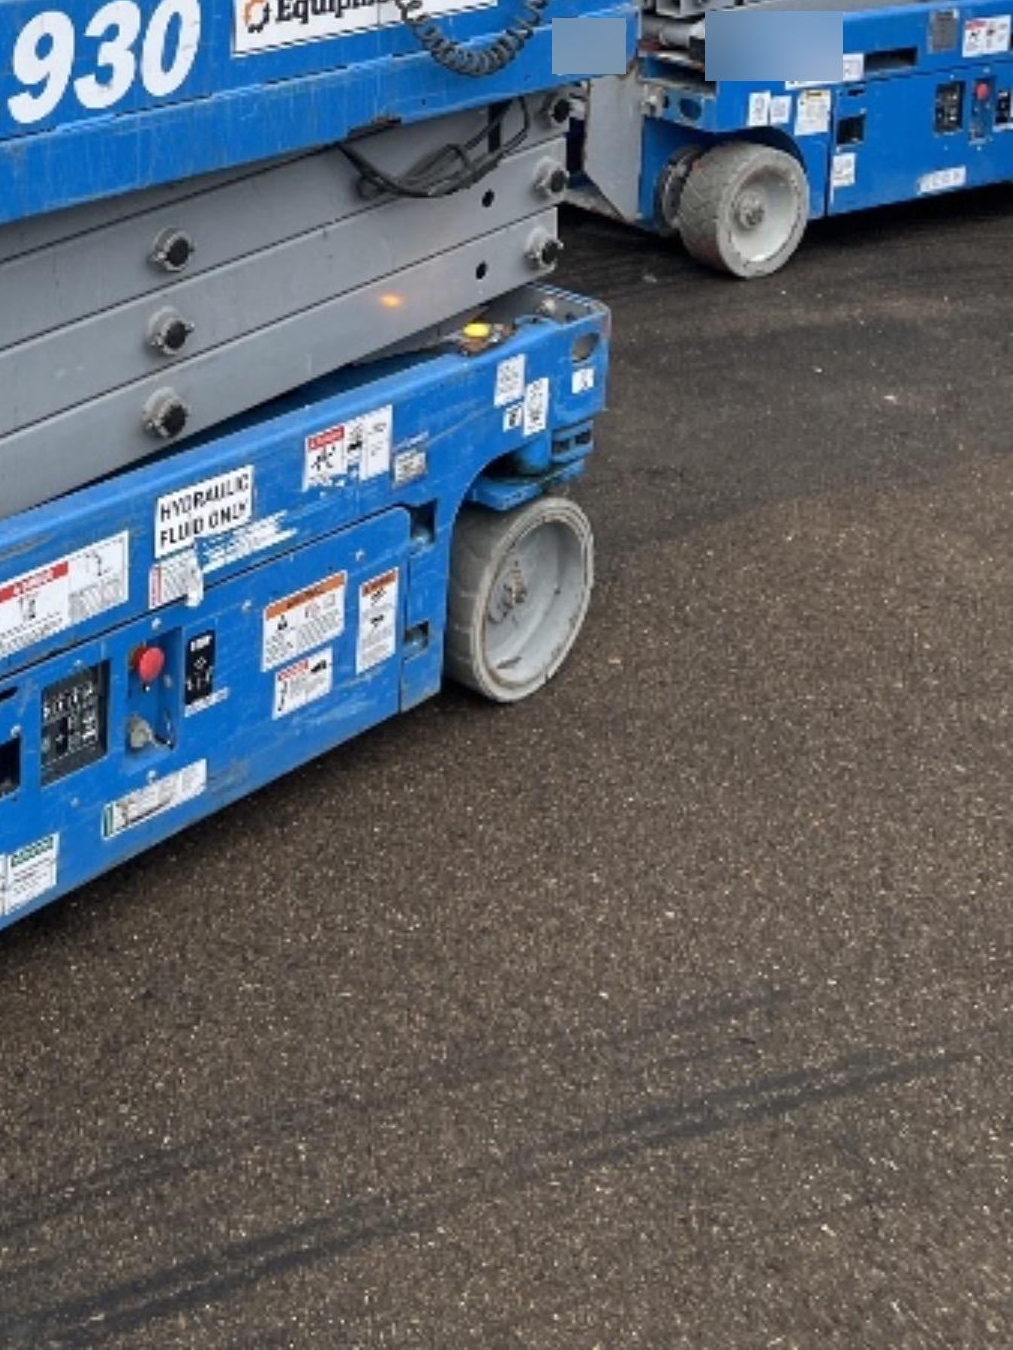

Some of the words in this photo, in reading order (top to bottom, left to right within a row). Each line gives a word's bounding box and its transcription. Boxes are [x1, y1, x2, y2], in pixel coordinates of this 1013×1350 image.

[160, 473, 249, 522] HYDRAULIC
[160, 518, 204, 547] FLUID
[209, 499, 248, 529] ONLY
